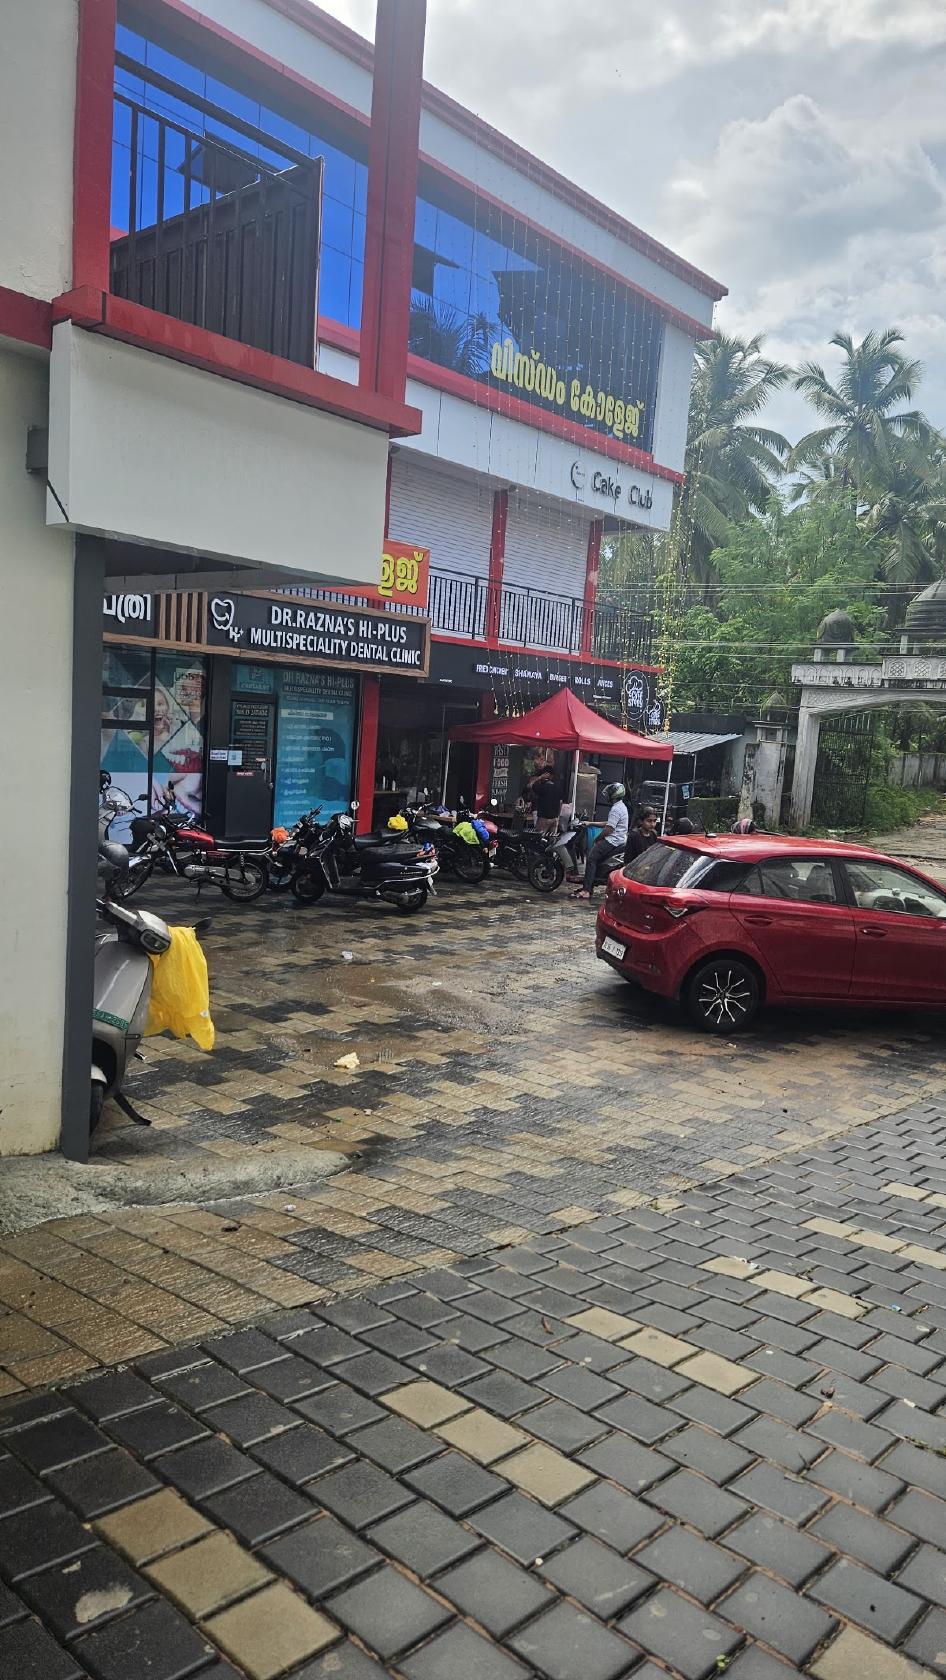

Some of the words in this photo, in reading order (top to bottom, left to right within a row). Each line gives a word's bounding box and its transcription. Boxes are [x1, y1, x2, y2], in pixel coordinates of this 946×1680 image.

[570, 378, 645, 438] കോളേജ്
[592, 471, 621, 499] Cake
[629, 485, 653, 510] Club
[250, 627, 349, 655] MULTISPECIALITY
[350, 642, 389, 661] DENTAL
[390, 647, 421, 665] CLINIC
[359, 618, 407, 644] HI-PLUS
